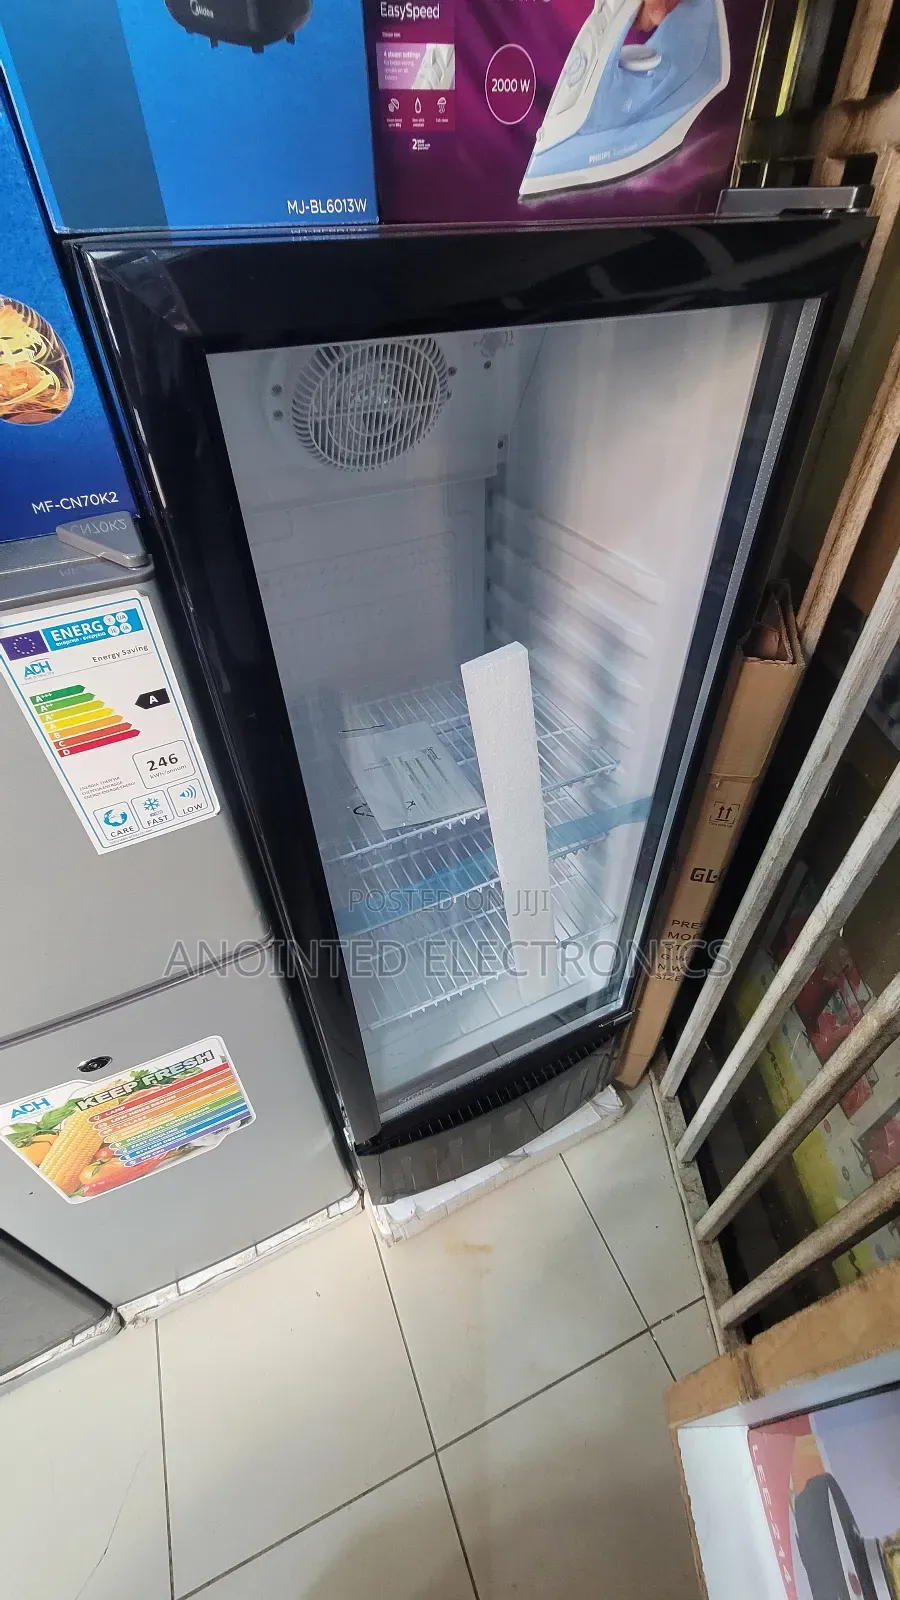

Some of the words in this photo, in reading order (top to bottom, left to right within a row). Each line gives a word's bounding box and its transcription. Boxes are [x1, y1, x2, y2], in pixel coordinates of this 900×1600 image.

[380, 1, 440, 21] EasySpeed
[491, 77, 518, 93] 2000
[520, 78, 531, 93] W
[412, 138, 418, 150] 2
[287, 198, 367, 214] MJ-BL6013W
[31, 491, 119, 515] MF-CN70K2
[51, 620, 104, 642] ENERG
[92, 650, 121, 663] Energy
[121, 644, 149, 656] Saving
[24, 660, 52, 677] ACH
[35, 692, 53, 703] A+++
[149, 695, 159, 705] A
[40, 703, 54, 712] A++
[146, 753, 179, 772] 246
[182, 803, 204, 815] LOW
[146, 814, 169, 827] FAST
[110, 825, 135, 838] CARE
[671, 919, 703, 929] PRE
[75, 1080, 138, 1111] KEEP
[141, 1049, 215, 1086] FRESH
[10, 1097, 51, 1120] ACH
[105, 1105, 126, 1114] LAMP
[111, 1114, 127, 1123] LOW
[127, 1126, 164, 1142] POWERFUL
[166, 1107, 210, 1127] COMPRESSOR
[163, 1132, 187, 1143] DESIGN
